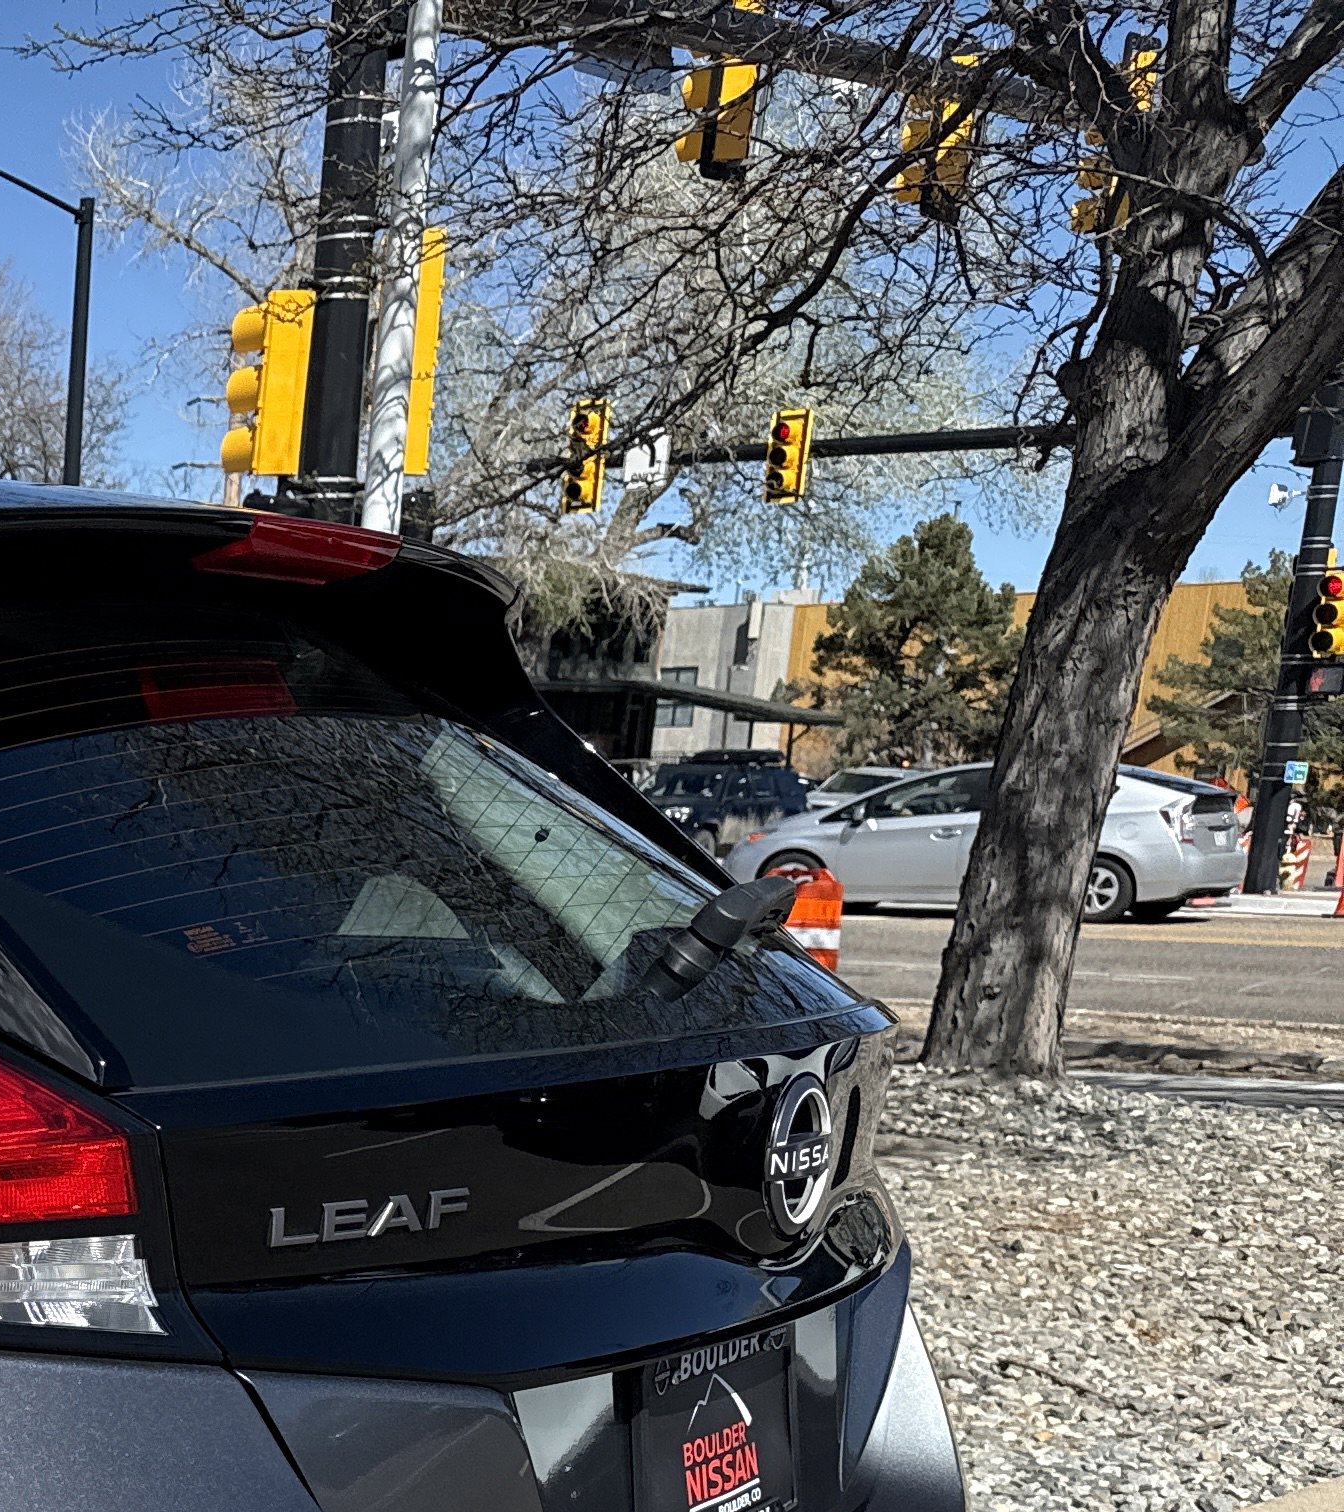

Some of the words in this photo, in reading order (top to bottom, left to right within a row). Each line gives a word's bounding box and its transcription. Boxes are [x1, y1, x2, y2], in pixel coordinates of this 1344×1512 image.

[770, 1142, 829, 1176] NISSA
[269, 1187, 470, 1248] LEAF
[679, 1333, 761, 1381] BOULDER
[682, 1420, 747, 1468] BOULDER
[685, 1441, 759, 1506] NISSAN
[751, 1487, 762, 1501] CO
